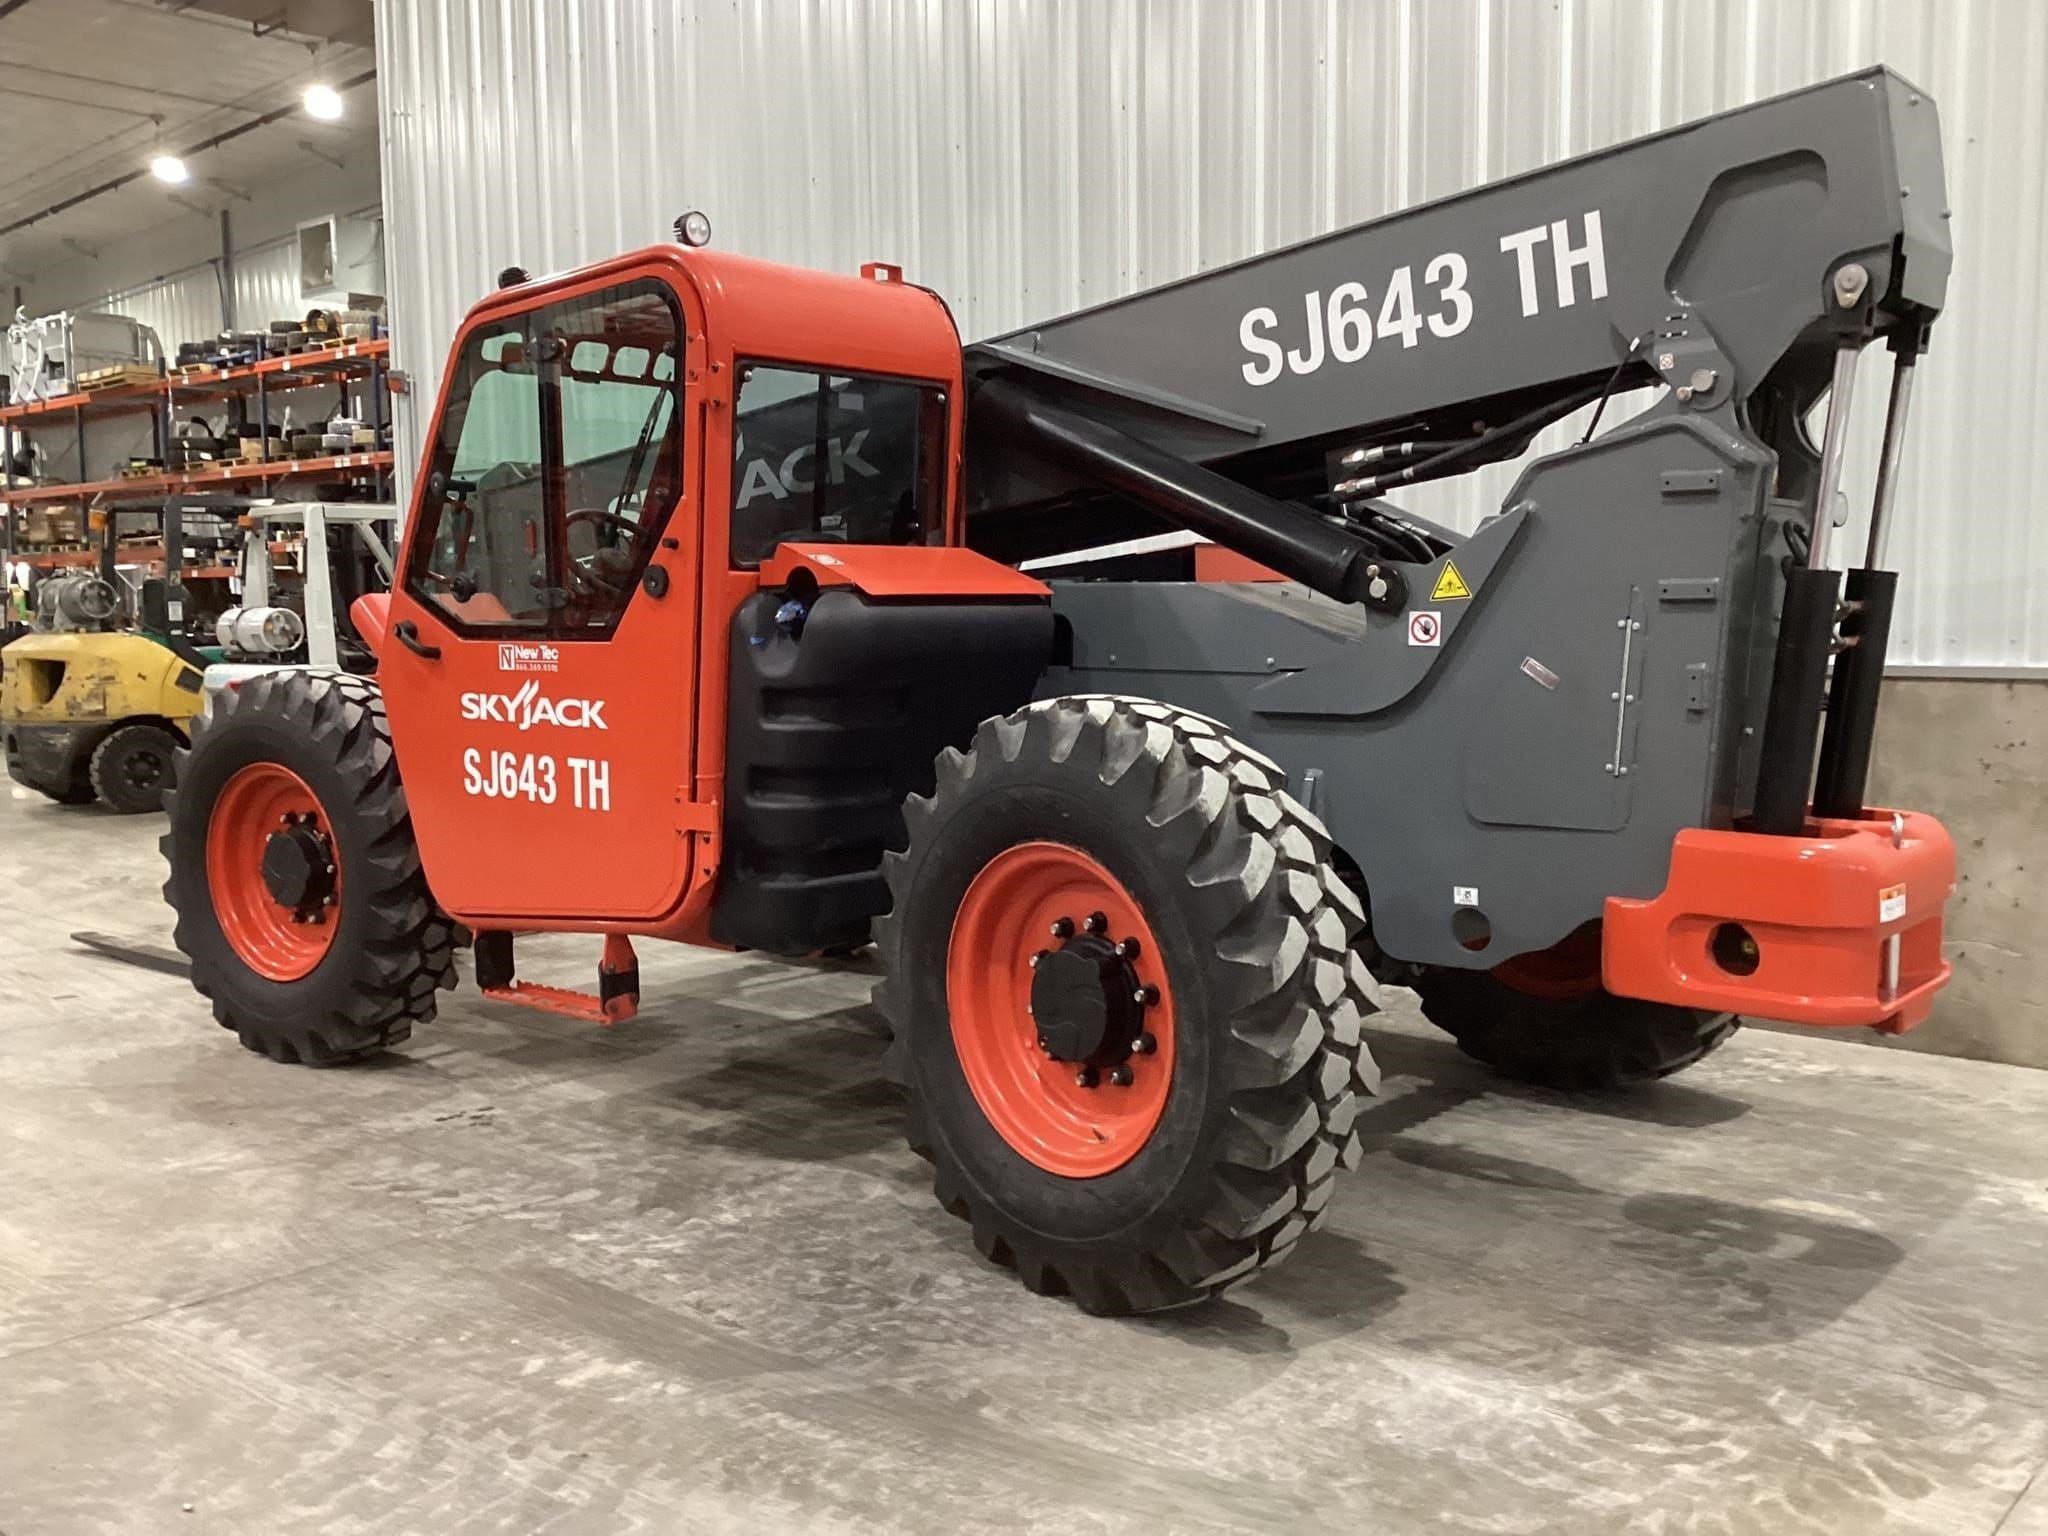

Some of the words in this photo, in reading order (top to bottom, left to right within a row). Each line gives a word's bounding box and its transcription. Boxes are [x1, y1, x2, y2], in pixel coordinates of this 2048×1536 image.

[1239, 252, 1473, 386] SJ643
[1500, 210, 1608, 317] TH
[736, 429, 881, 510] ACK
[515, 644, 539, 660] New
[539, 645, 559, 660] Tec
[460, 679, 608, 731] SKYJACK
[463, 747, 557, 804] SJ643
[567, 757, 610, 811] TH
